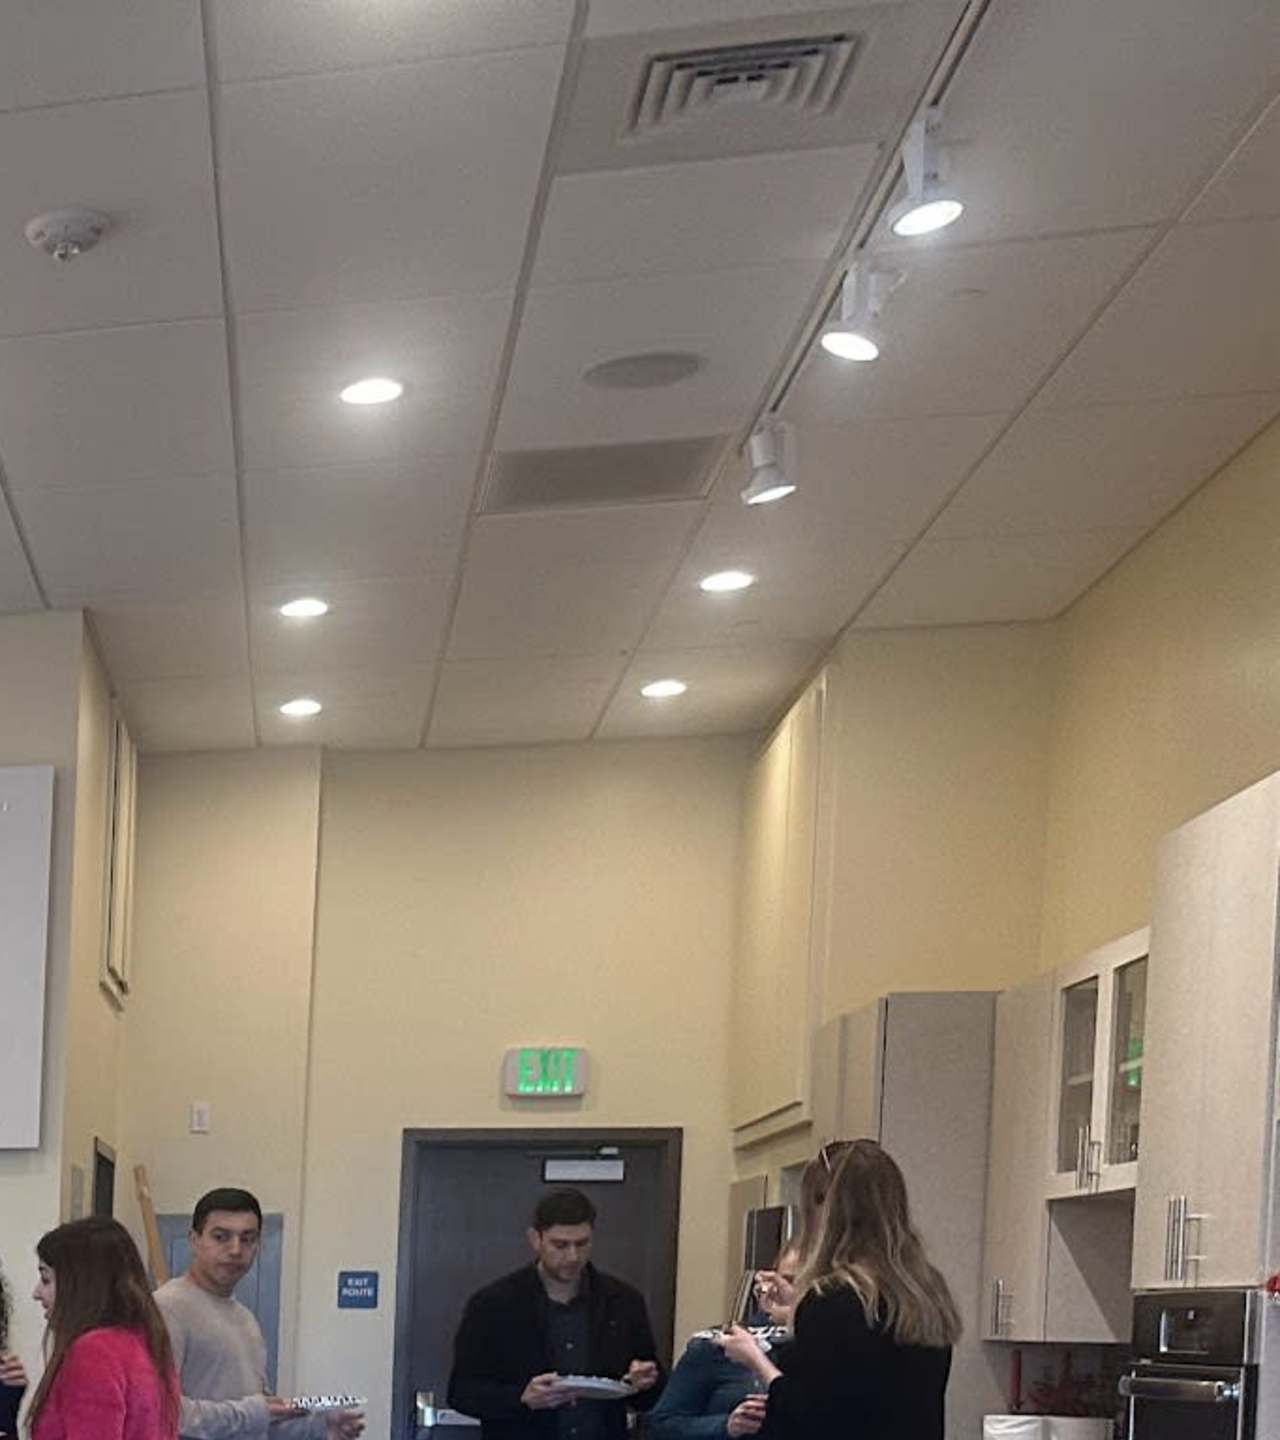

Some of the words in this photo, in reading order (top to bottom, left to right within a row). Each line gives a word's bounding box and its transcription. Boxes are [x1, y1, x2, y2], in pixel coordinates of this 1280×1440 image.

[518, 1048, 577, 1092] EXIT
[347, 1278, 368, 1286] EXIT
[342, 1288, 374, 1297] ROUTE
